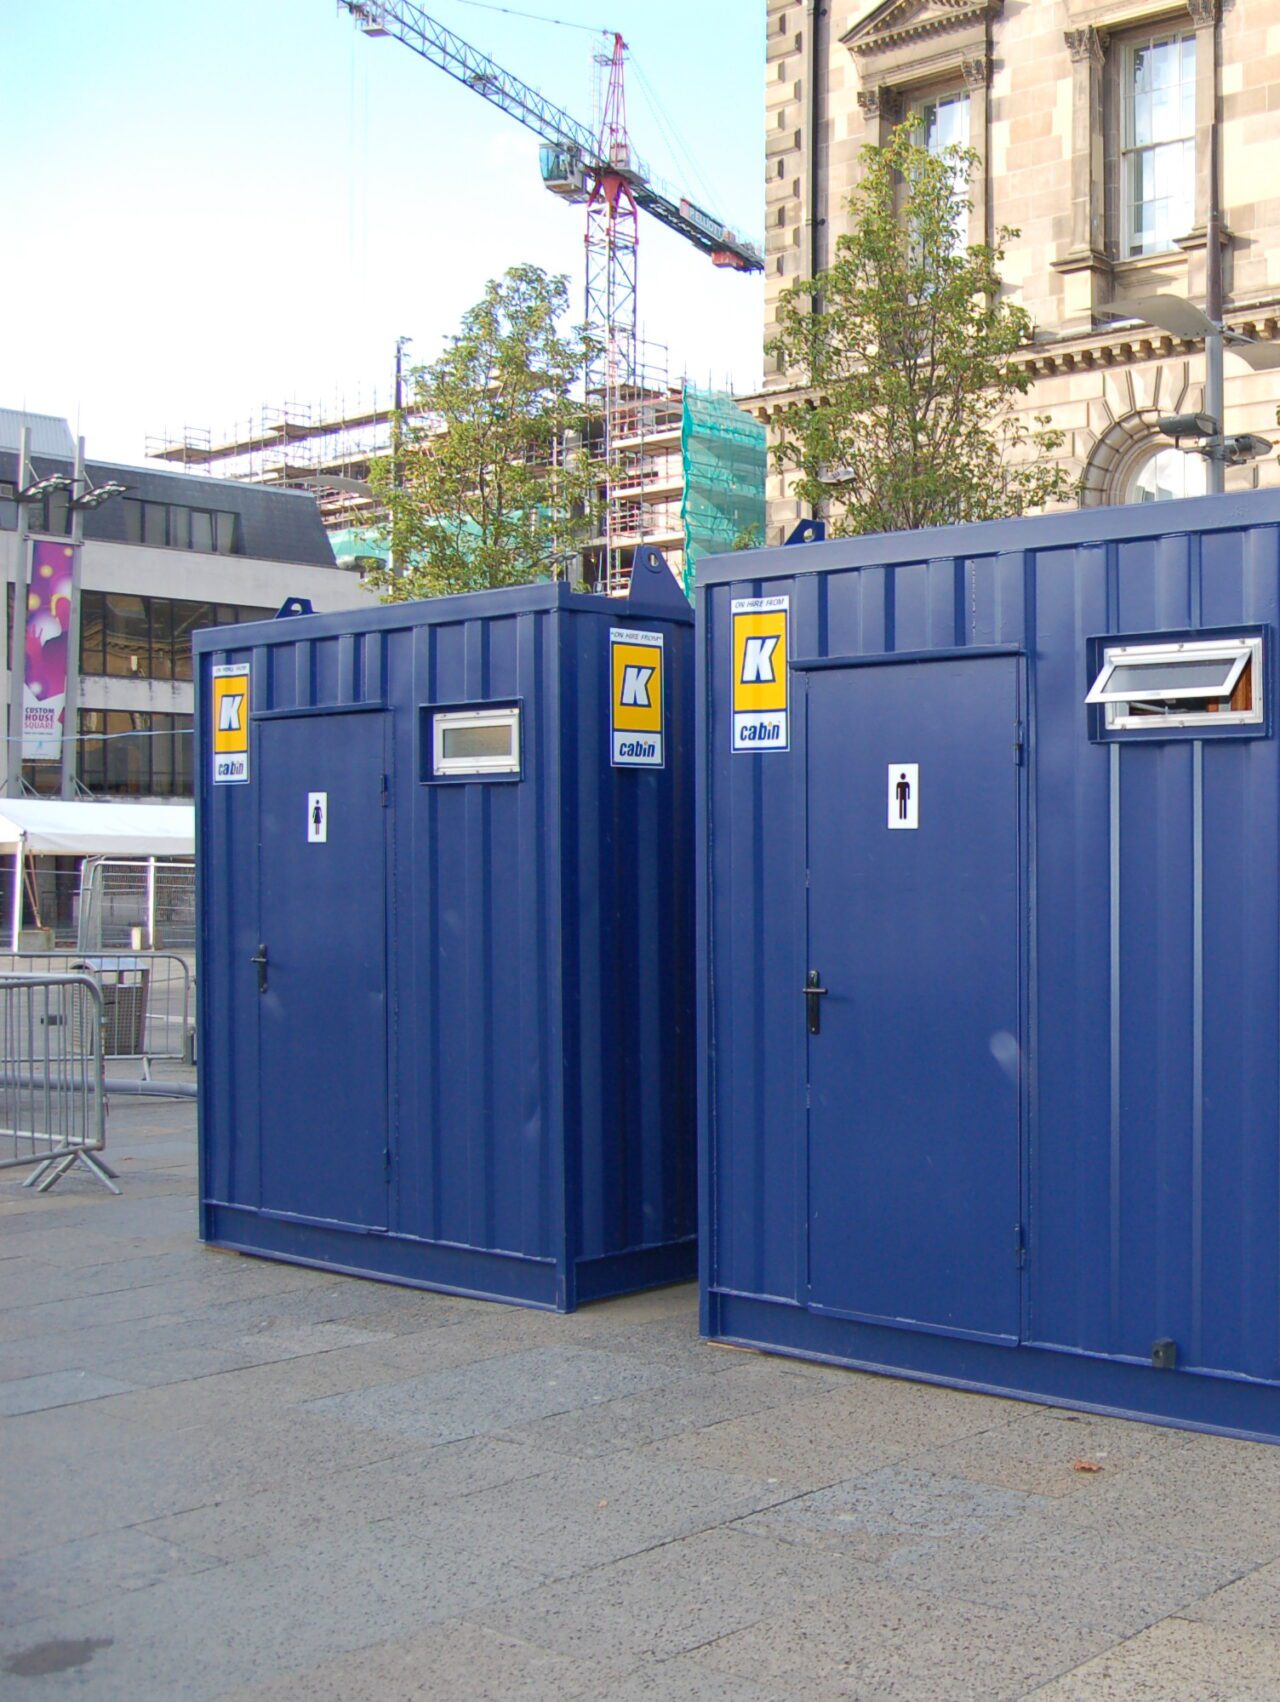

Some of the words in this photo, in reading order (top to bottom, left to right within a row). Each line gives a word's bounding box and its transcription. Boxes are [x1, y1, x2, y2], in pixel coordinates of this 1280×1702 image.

[740, 635, 781, 684] K
[620, 664, 656, 708] K
[219, 694, 244, 731] K
[740, 721, 780, 741] cabin
[619, 740, 656, 758] cabin
[218, 760, 244, 776] cabin
